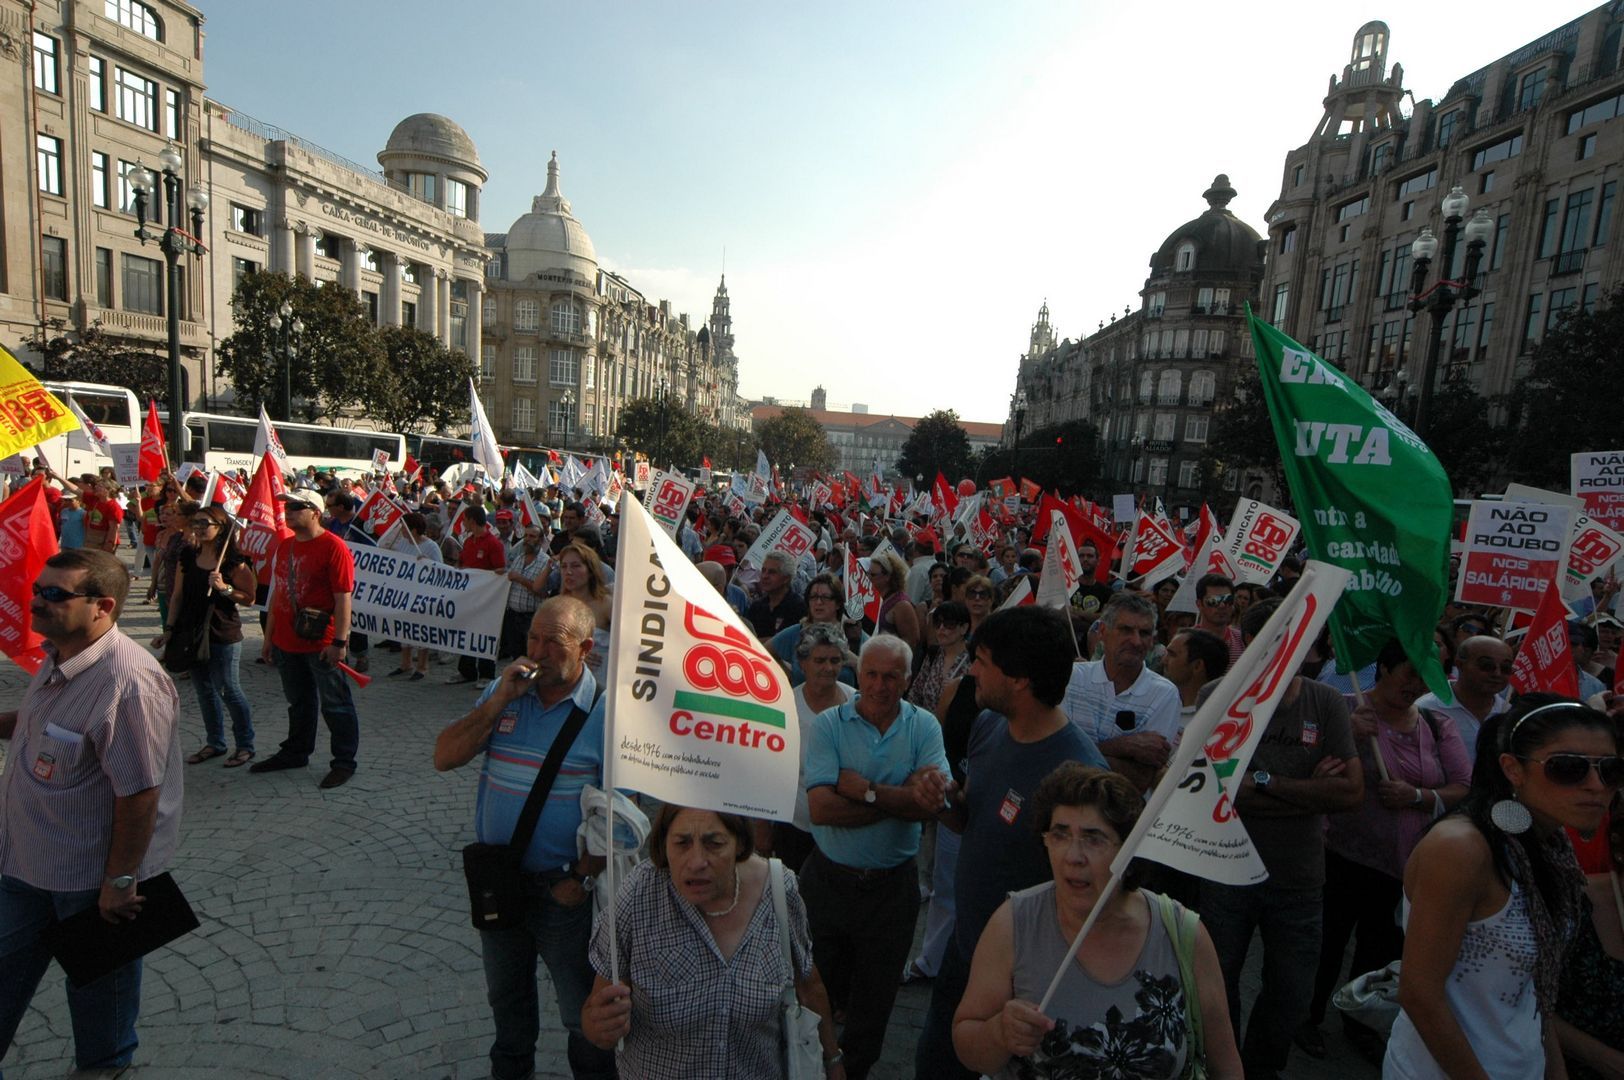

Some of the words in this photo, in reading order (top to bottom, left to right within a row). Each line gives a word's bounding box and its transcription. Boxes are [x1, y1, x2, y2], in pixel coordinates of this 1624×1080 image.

[322, 203, 350, 222] CAIXA
[1294, 417, 1392, 466] UTA
[1590, 453, 1624, 466] NÃ
[1580, 477, 1624, 487] ROU
[1491, 507, 1548, 522] NÃO
[1584, 504, 1624, 518] ALÁR
[761, 515, 791, 549] SINDICATO
[1230, 501, 1259, 555] SINDICATO
[1497, 522, 1536, 535] AO
[241, 528, 272, 555] STAL
[1474, 534, 1560, 552] ROUBO
[353, 549, 396, 576] DORES
[397, 560, 415, 581] DA
[1237, 559, 1270, 575] Centro
[1492, 558, 1529, 570] NOS
[1466, 571, 1549, 593] SALÁRIOS
[367, 582, 410, 611] TÁBUA
[410, 594, 456, 619] ESTÃO
[631, 539, 671, 702] SINDICA
[351, 610, 377, 633] COM
[381, 618, 391, 636] A
[394, 619, 466, 649] PRESENTE
[470, 632, 497, 655] LUT
[668, 710, 785, 752] Centro
[621, 735, 643, 753] desde
[643, 742, 661, 758] 1976
[1166, 823, 1196, 840] 1976
